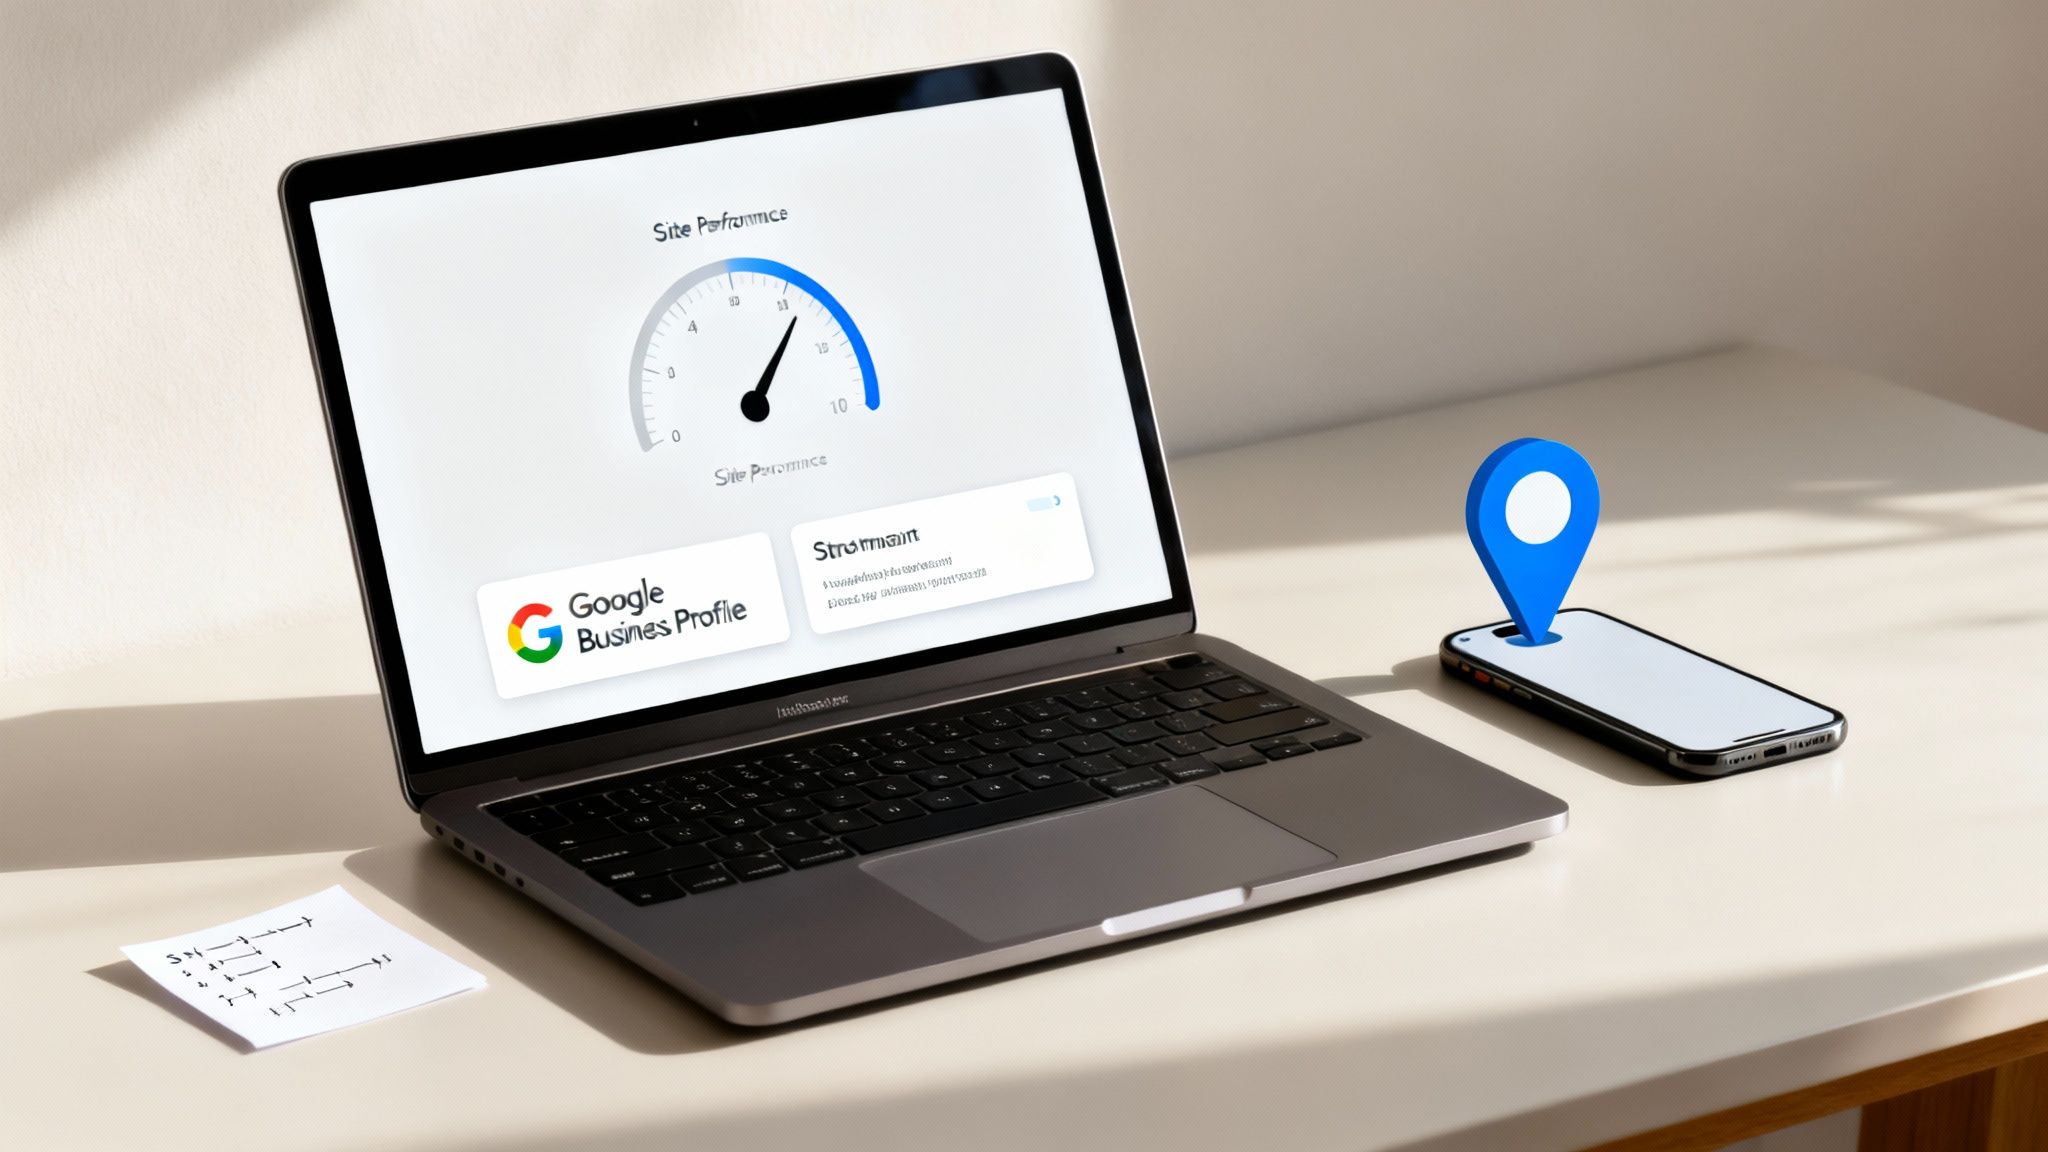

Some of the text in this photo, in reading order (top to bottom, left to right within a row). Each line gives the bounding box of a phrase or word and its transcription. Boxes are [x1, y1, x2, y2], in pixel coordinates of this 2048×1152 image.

[653, 221, 692, 242] Site
[671, 429, 682, 443] 0
[568, 577, 664, 619] Google
